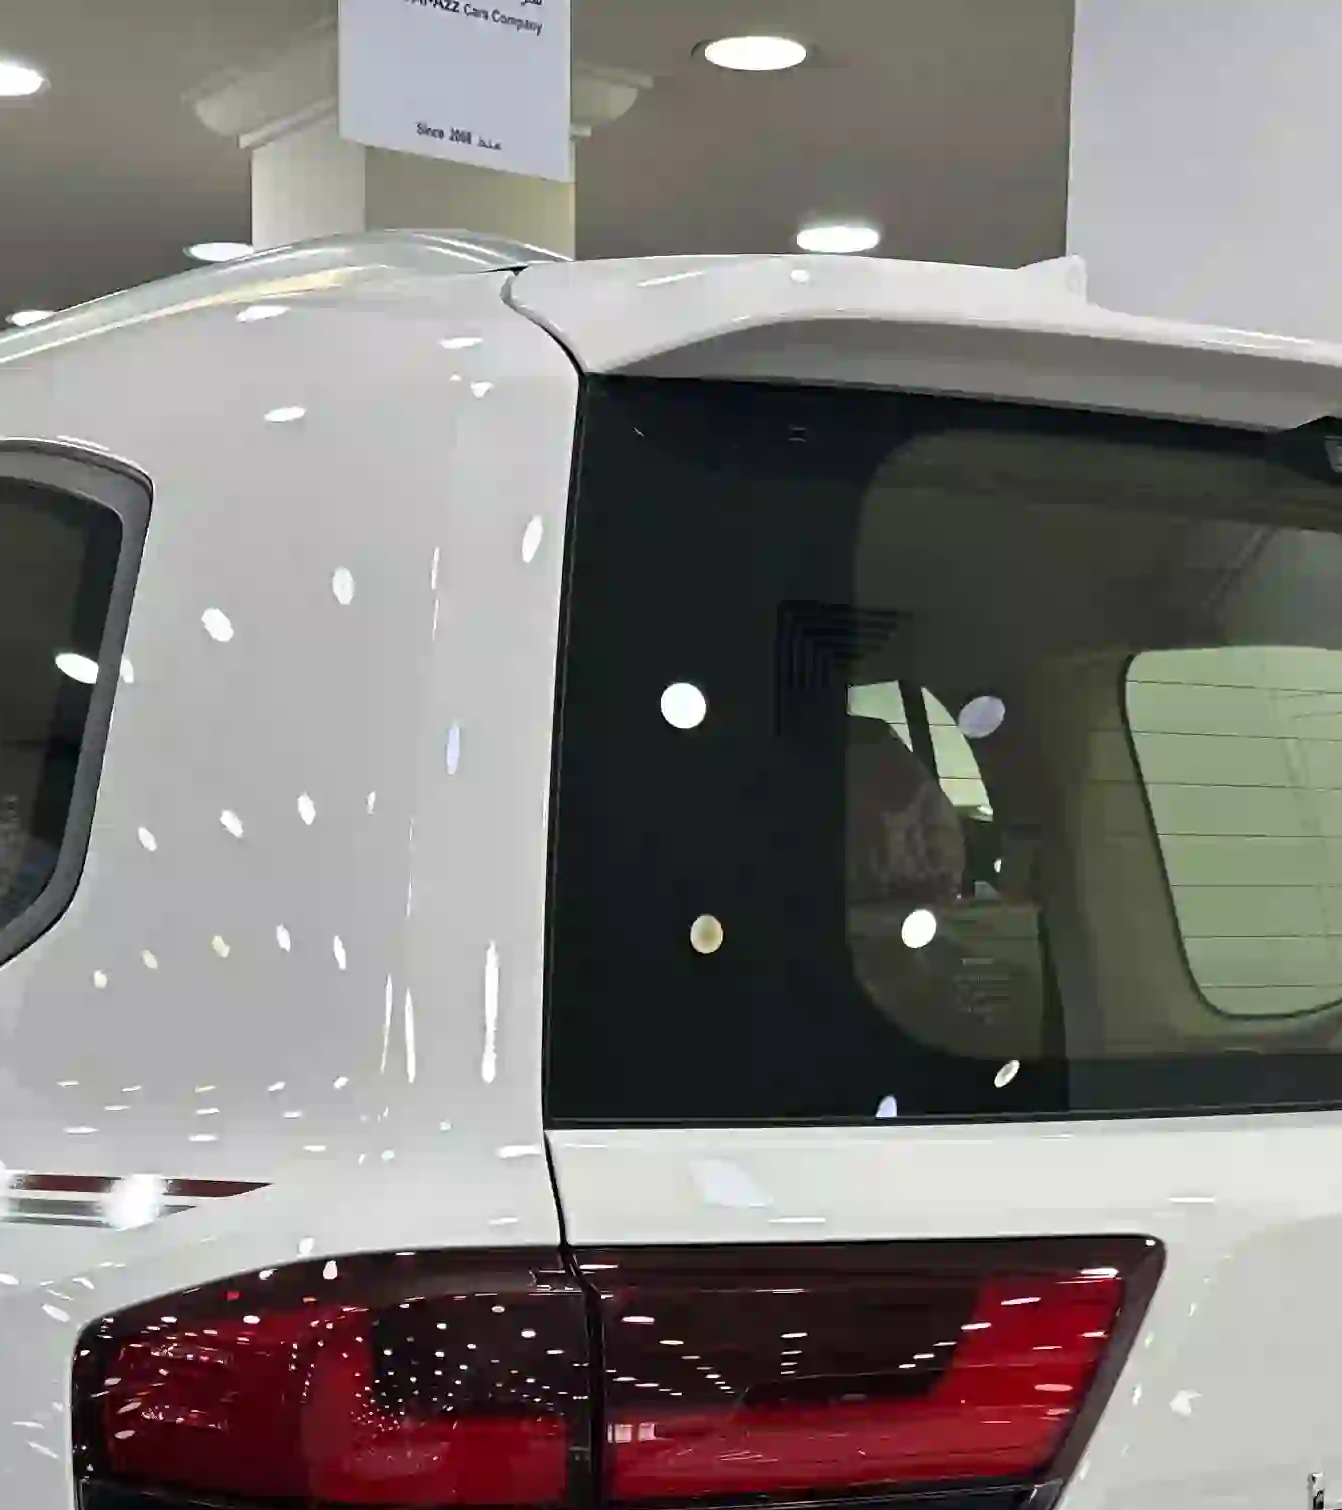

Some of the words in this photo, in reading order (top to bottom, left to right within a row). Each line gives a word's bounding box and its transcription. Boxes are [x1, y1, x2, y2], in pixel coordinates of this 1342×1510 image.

[463, 3, 489, 20] Cars
[491, 9, 543, 36] Company
[416, 122, 444, 139] Since
